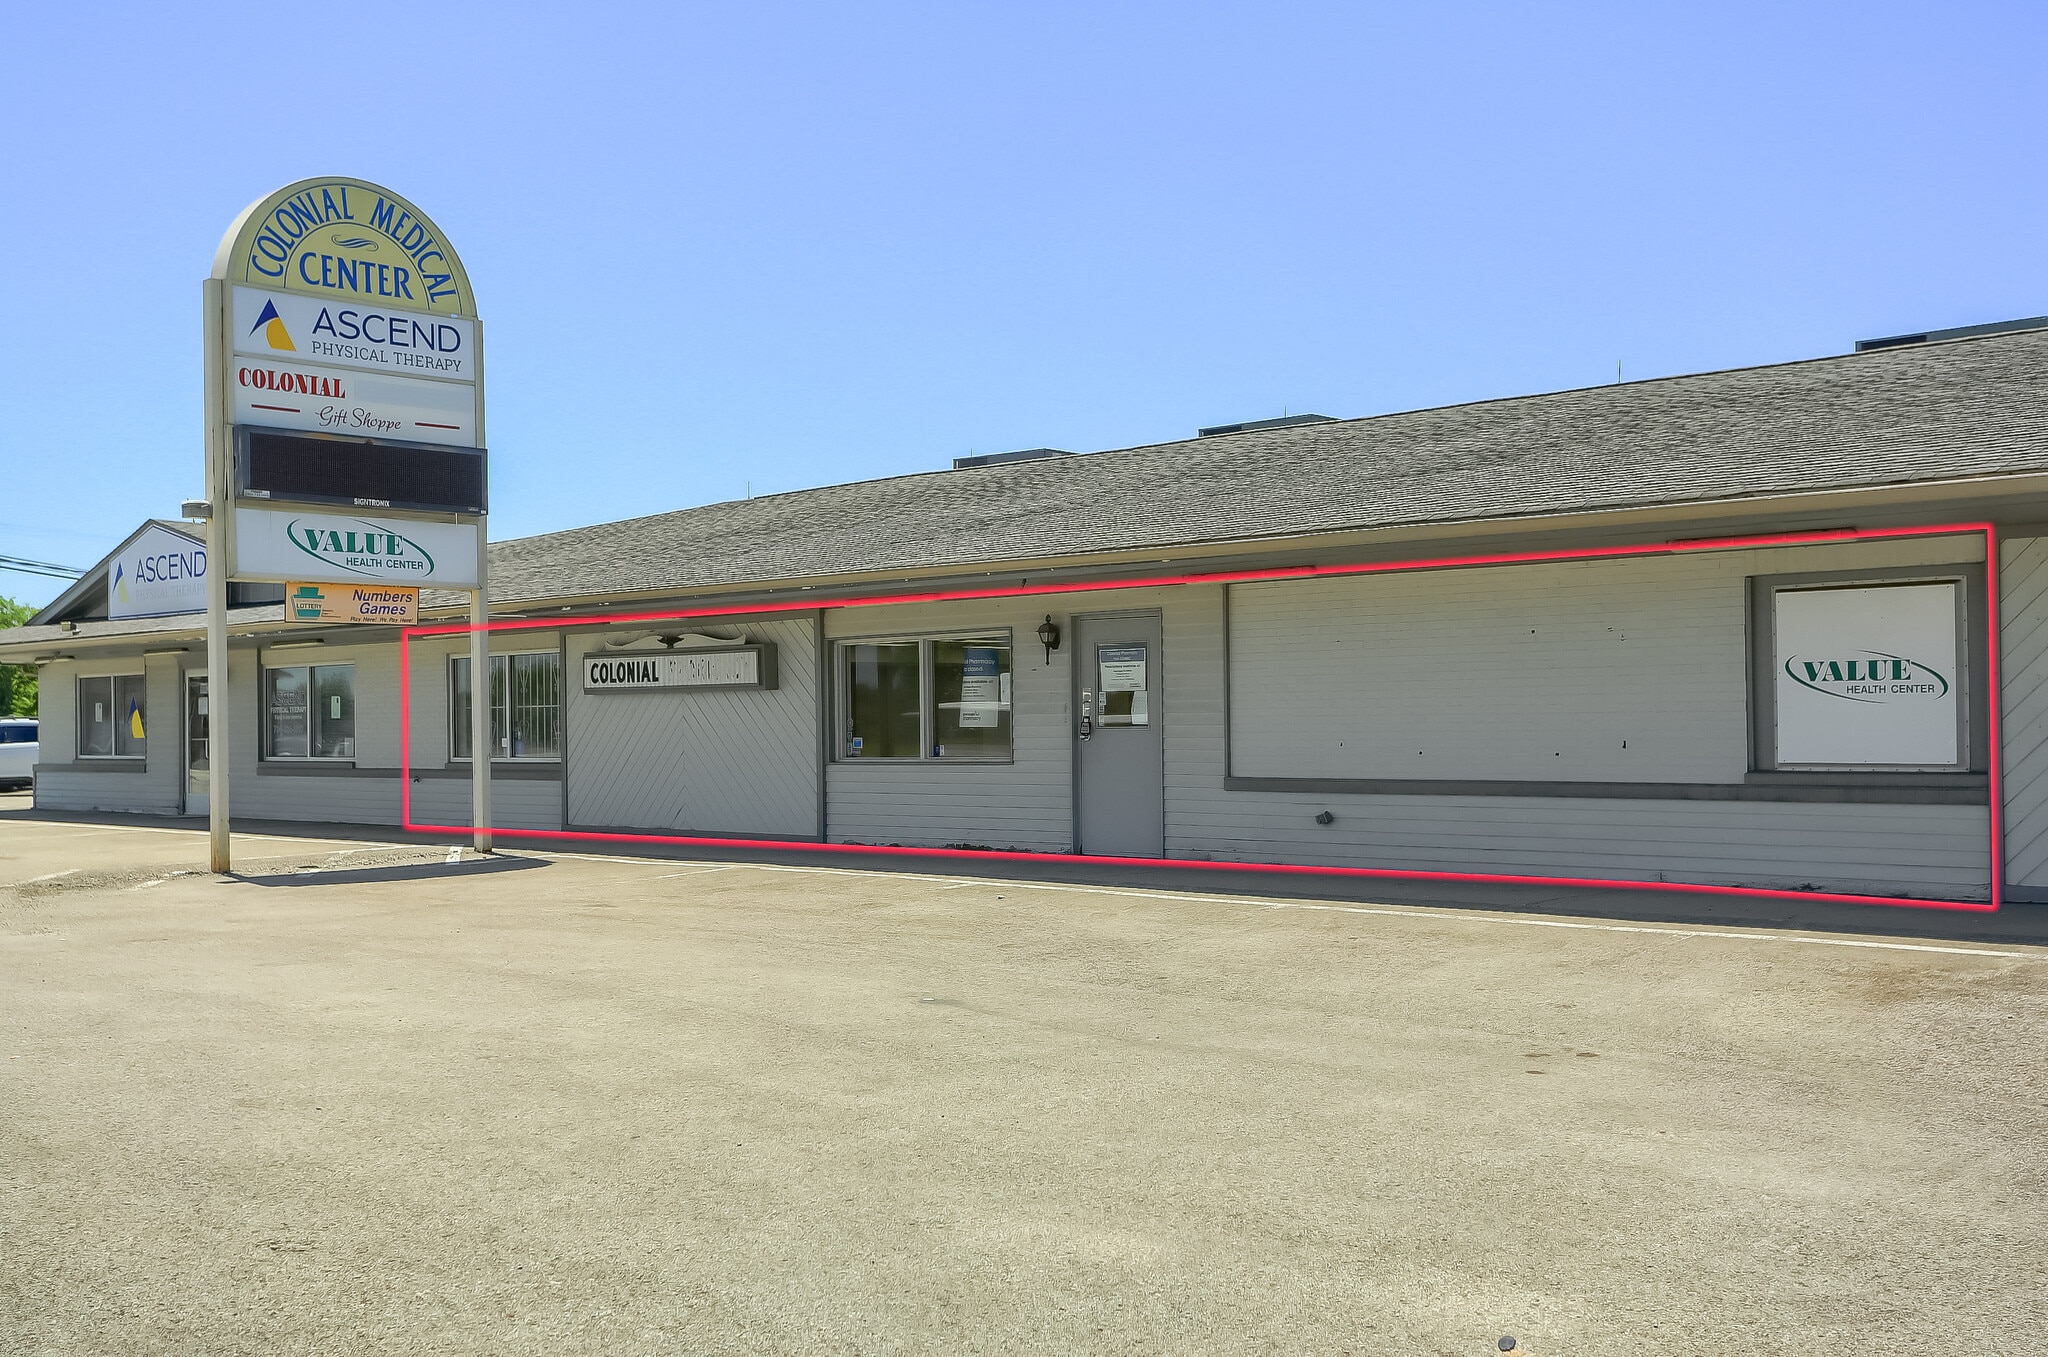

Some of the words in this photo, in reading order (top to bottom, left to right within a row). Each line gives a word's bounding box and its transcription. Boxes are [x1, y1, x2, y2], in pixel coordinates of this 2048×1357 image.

[251, 187, 354, 277] COLONIAL
[369, 196, 456, 304] MEDICAL
[300, 252, 414, 300] CENTER
[311, 307, 461, 353] ASCEND
[311, 341, 389, 364] PHYSICAL
[393, 351, 462, 373] THERAPY
[238, 367, 346, 399] COLONIAL
[314, 406, 348, 427] Gift
[350, 407, 402, 432] Shoppe
[353, 497, 391, 508] SIGNTRONIX
[303, 528, 404, 556] VALUE
[135, 551, 207, 584] ASCEND
[346, 557, 383, 568] HEALTH
[386, 559, 424, 570] CENTER
[352, 589, 413, 603] Numbers
[359, 602, 407, 615] Games
[590, 660, 659, 684] COLONIAL
[1802, 658, 1912, 682] VALUE
[1846, 684, 1887, 695] HEALTH
[1891, 683, 1935, 694] CENTER
